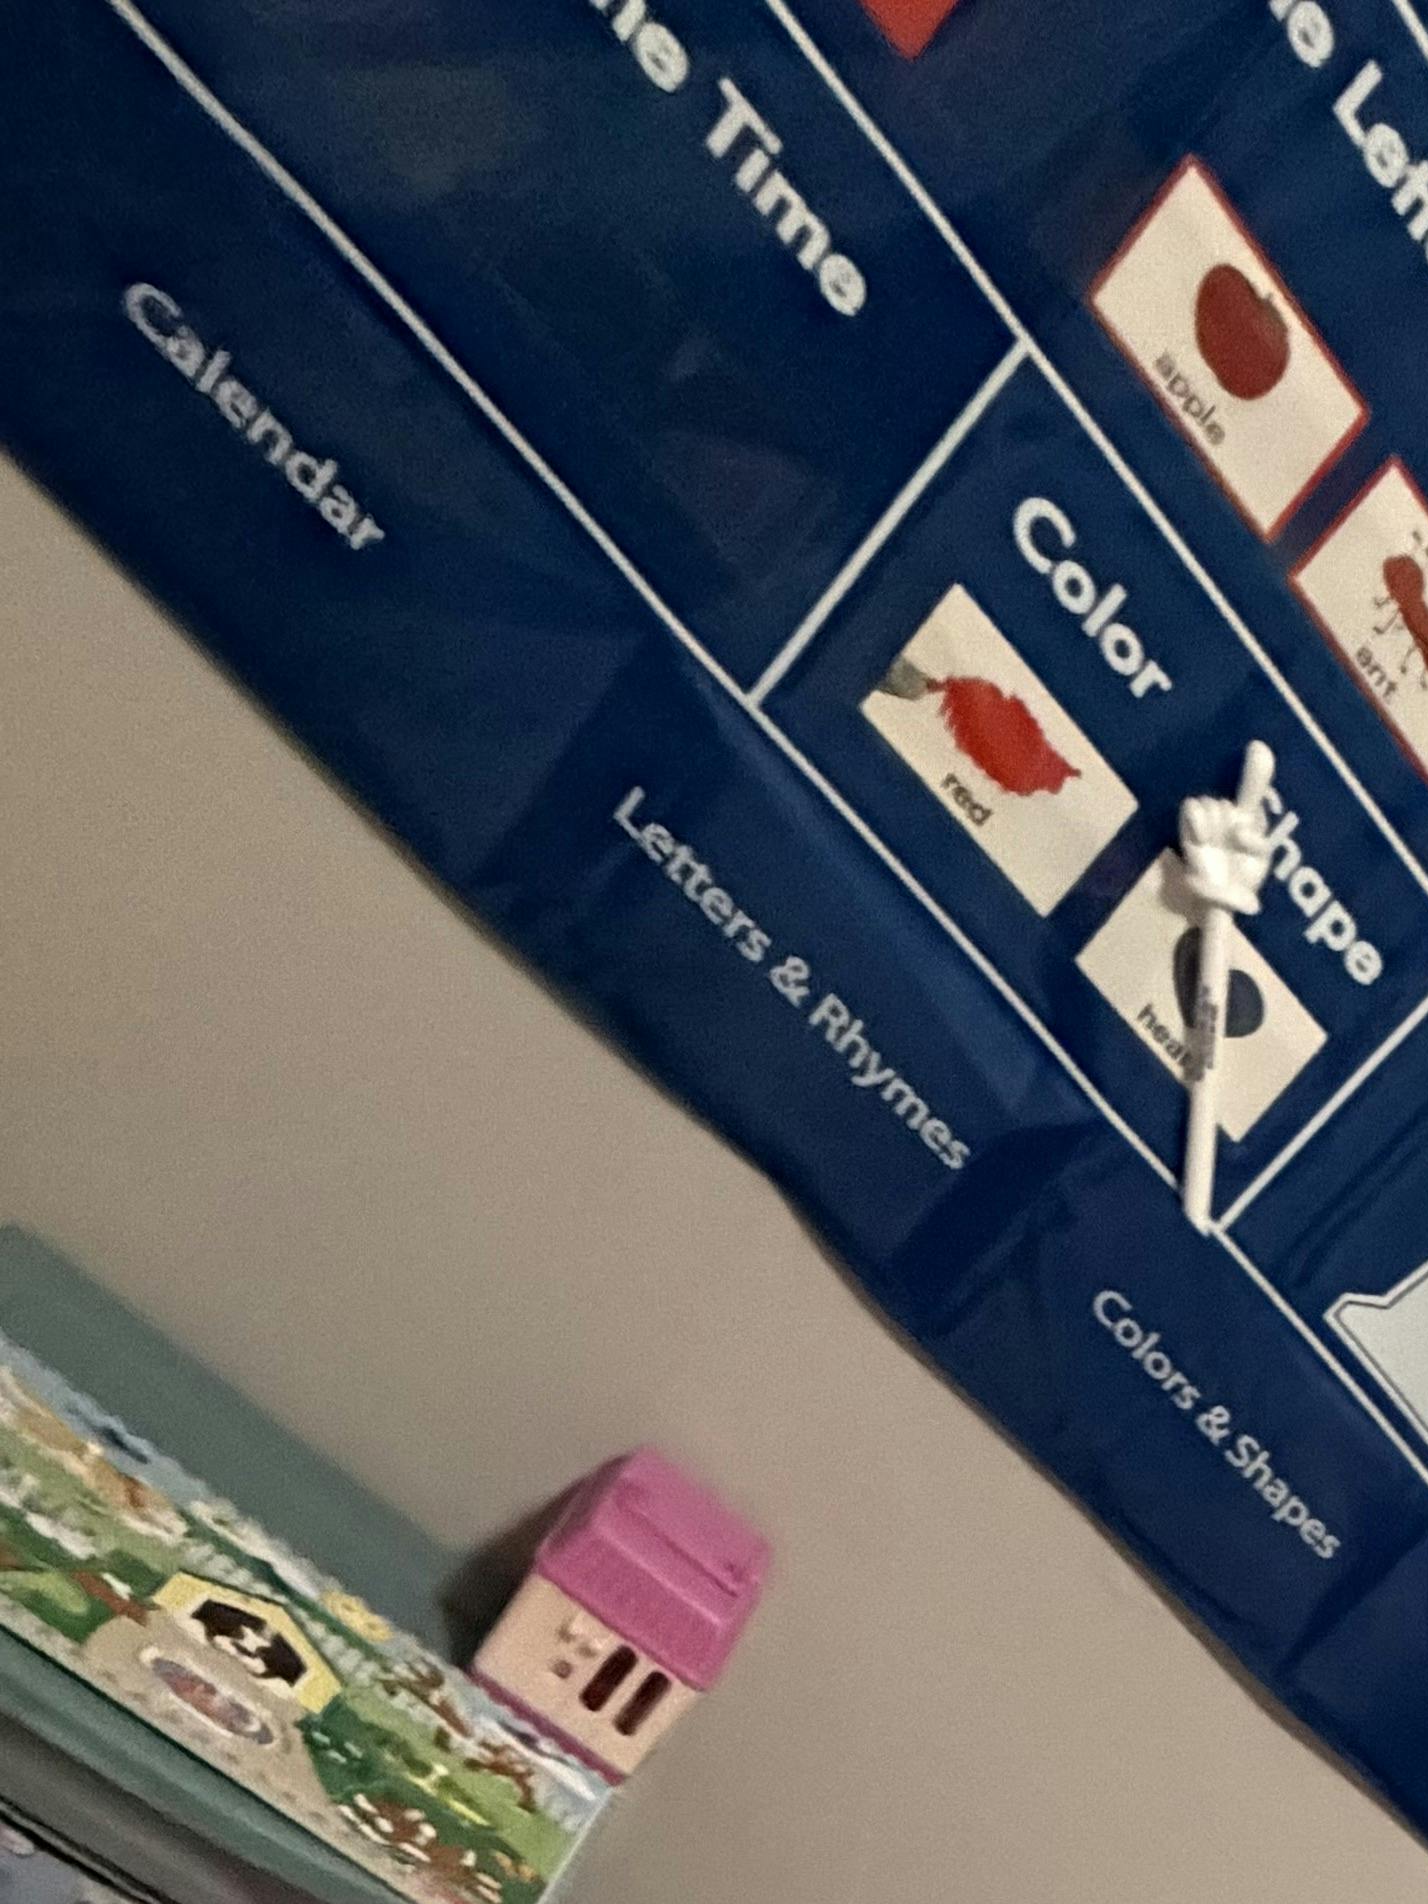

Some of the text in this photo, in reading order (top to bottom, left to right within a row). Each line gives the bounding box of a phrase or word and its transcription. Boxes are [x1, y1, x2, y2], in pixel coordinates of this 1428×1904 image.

[706, 78, 868, 318] Time
[122, 282, 386, 552] Calendar
[1154, 351, 1226, 446] apple
[1013, 497, 1174, 699] Color
[1354, 646, 1398, 702] ant
[940, 772, 991, 828] red
[614, 787, 971, 1171] Letters & Rhymes
[1093, 1289, 1342, 1560] Colors & Shapes
